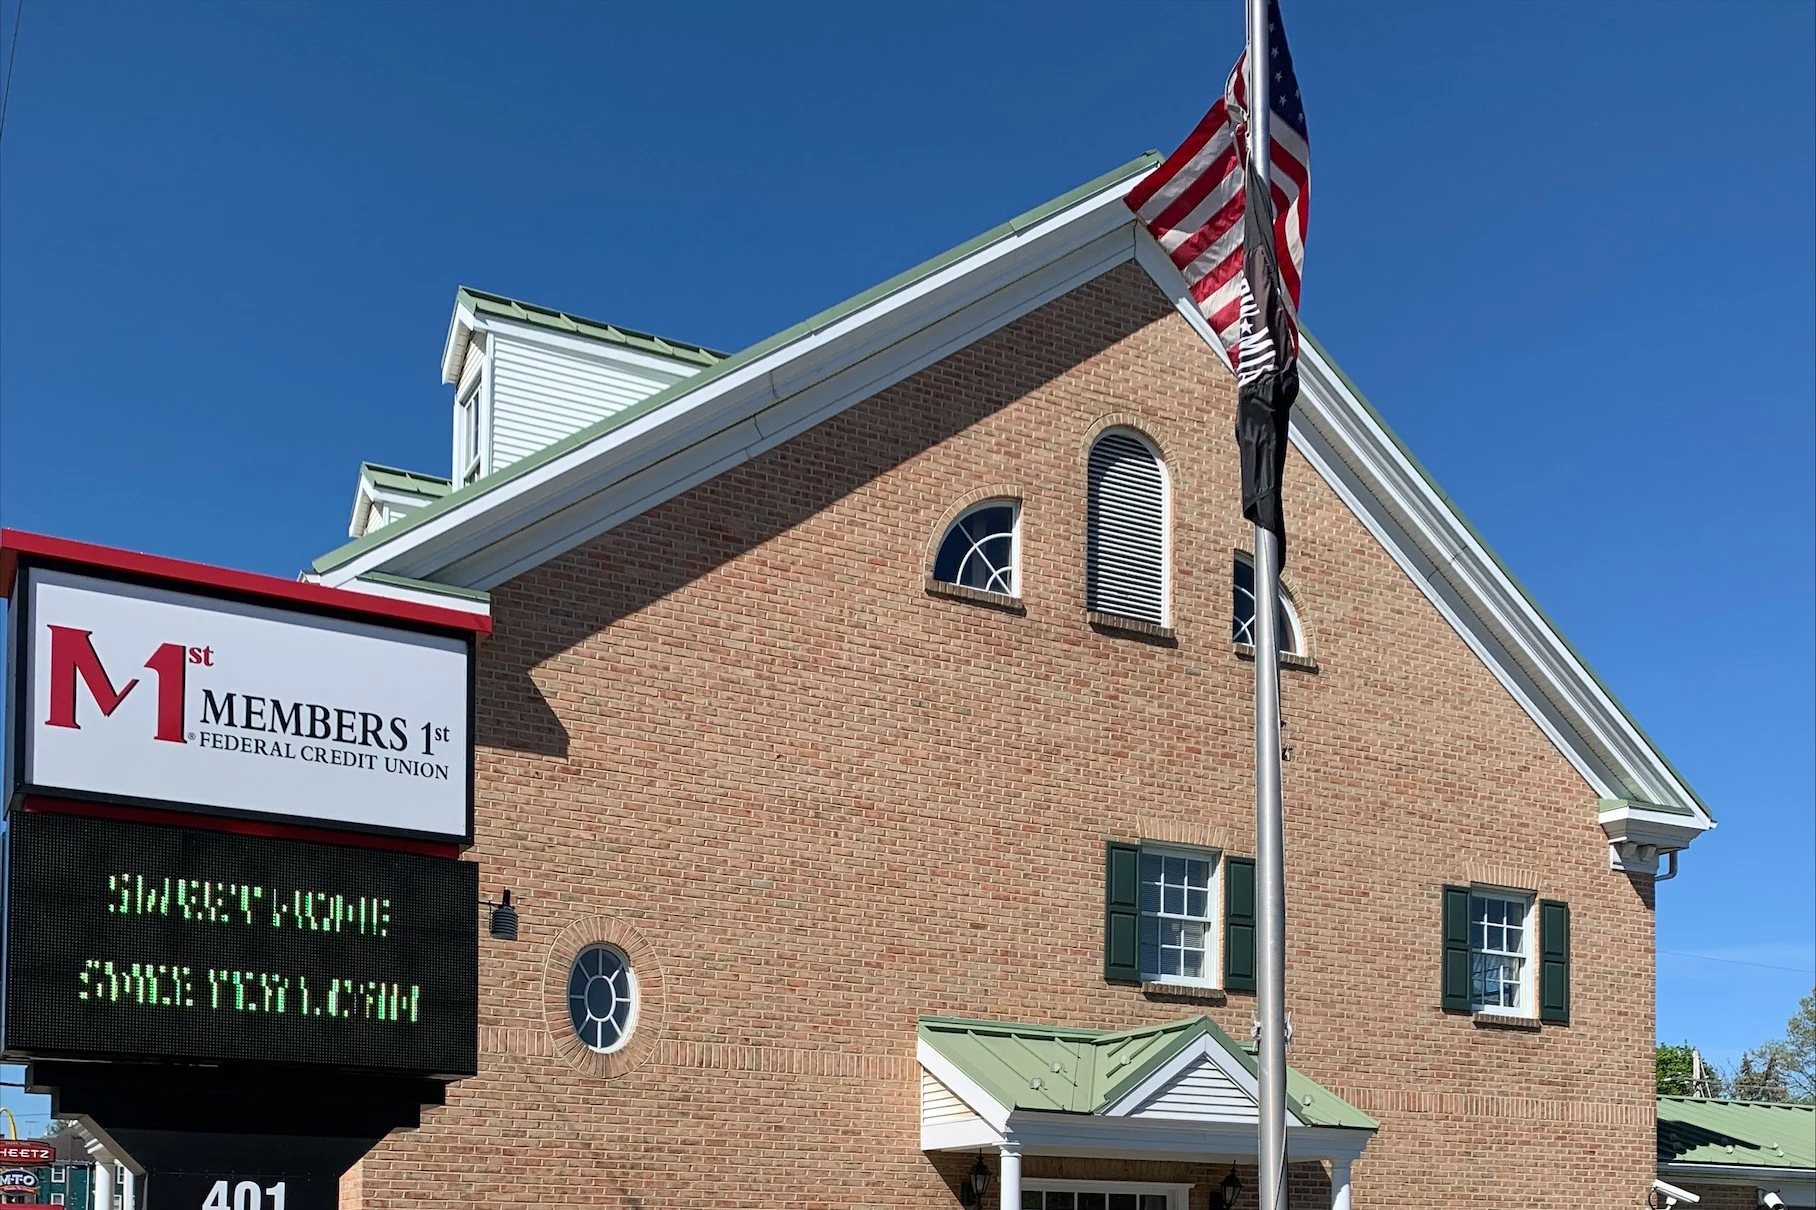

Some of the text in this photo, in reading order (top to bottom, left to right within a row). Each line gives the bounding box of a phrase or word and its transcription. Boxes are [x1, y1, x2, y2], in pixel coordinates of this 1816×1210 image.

[200, 689, 450, 755] MEMBERS 1st
[199, 732, 449, 780] FEDERAL CREDIT UNION
[0, 1148, 49, 1159] HEETZ
